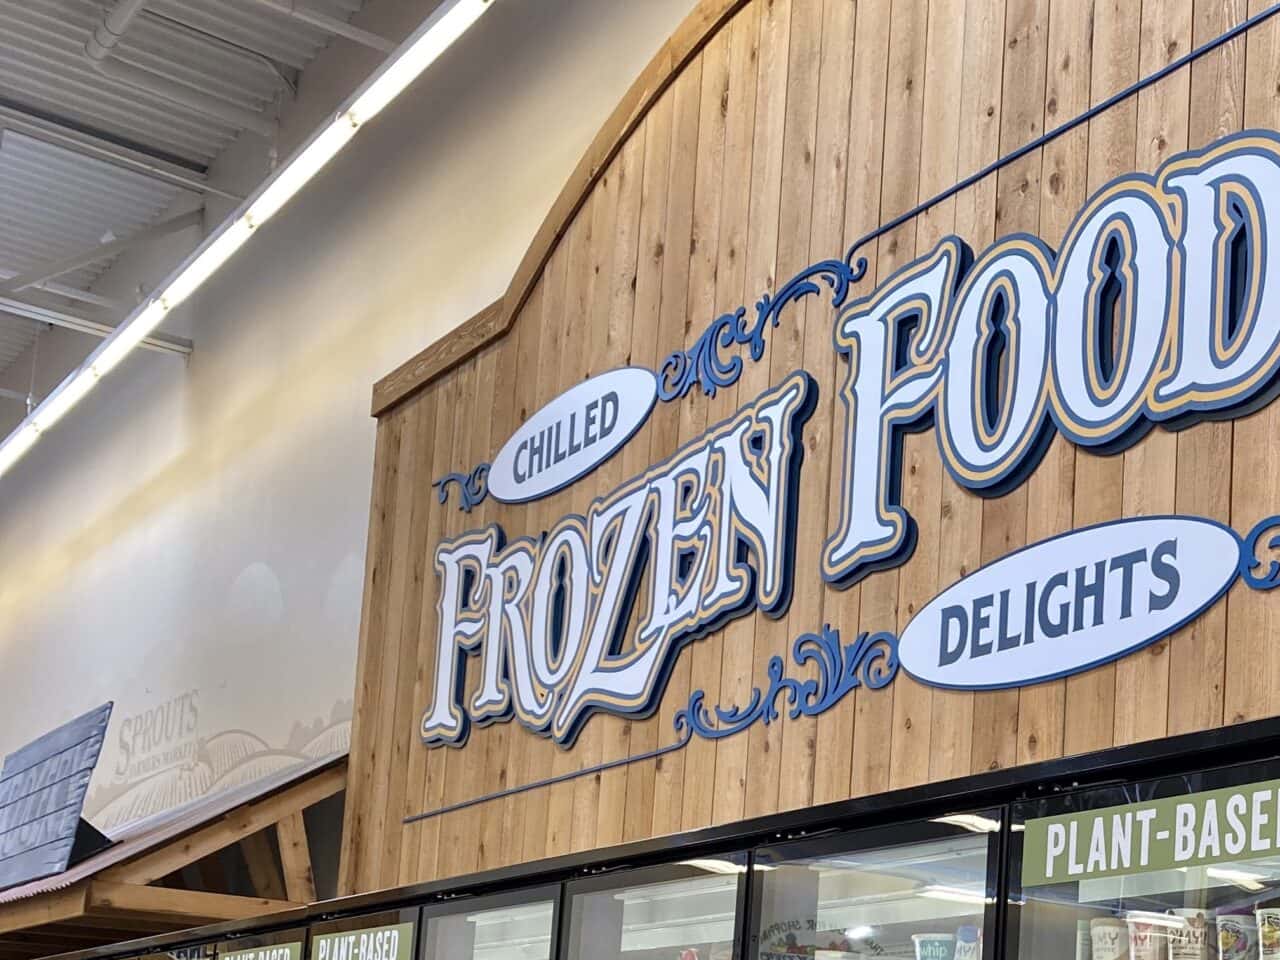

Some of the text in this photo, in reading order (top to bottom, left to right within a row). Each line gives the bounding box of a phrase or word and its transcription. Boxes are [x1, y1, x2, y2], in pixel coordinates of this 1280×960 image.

[512, 393, 621, 485] CHILLED
[419, 369, 818, 749] FROZEN
[937, 538, 1182, 667] DELIGHTS
[116, 689, 200, 777] SPROUTS
